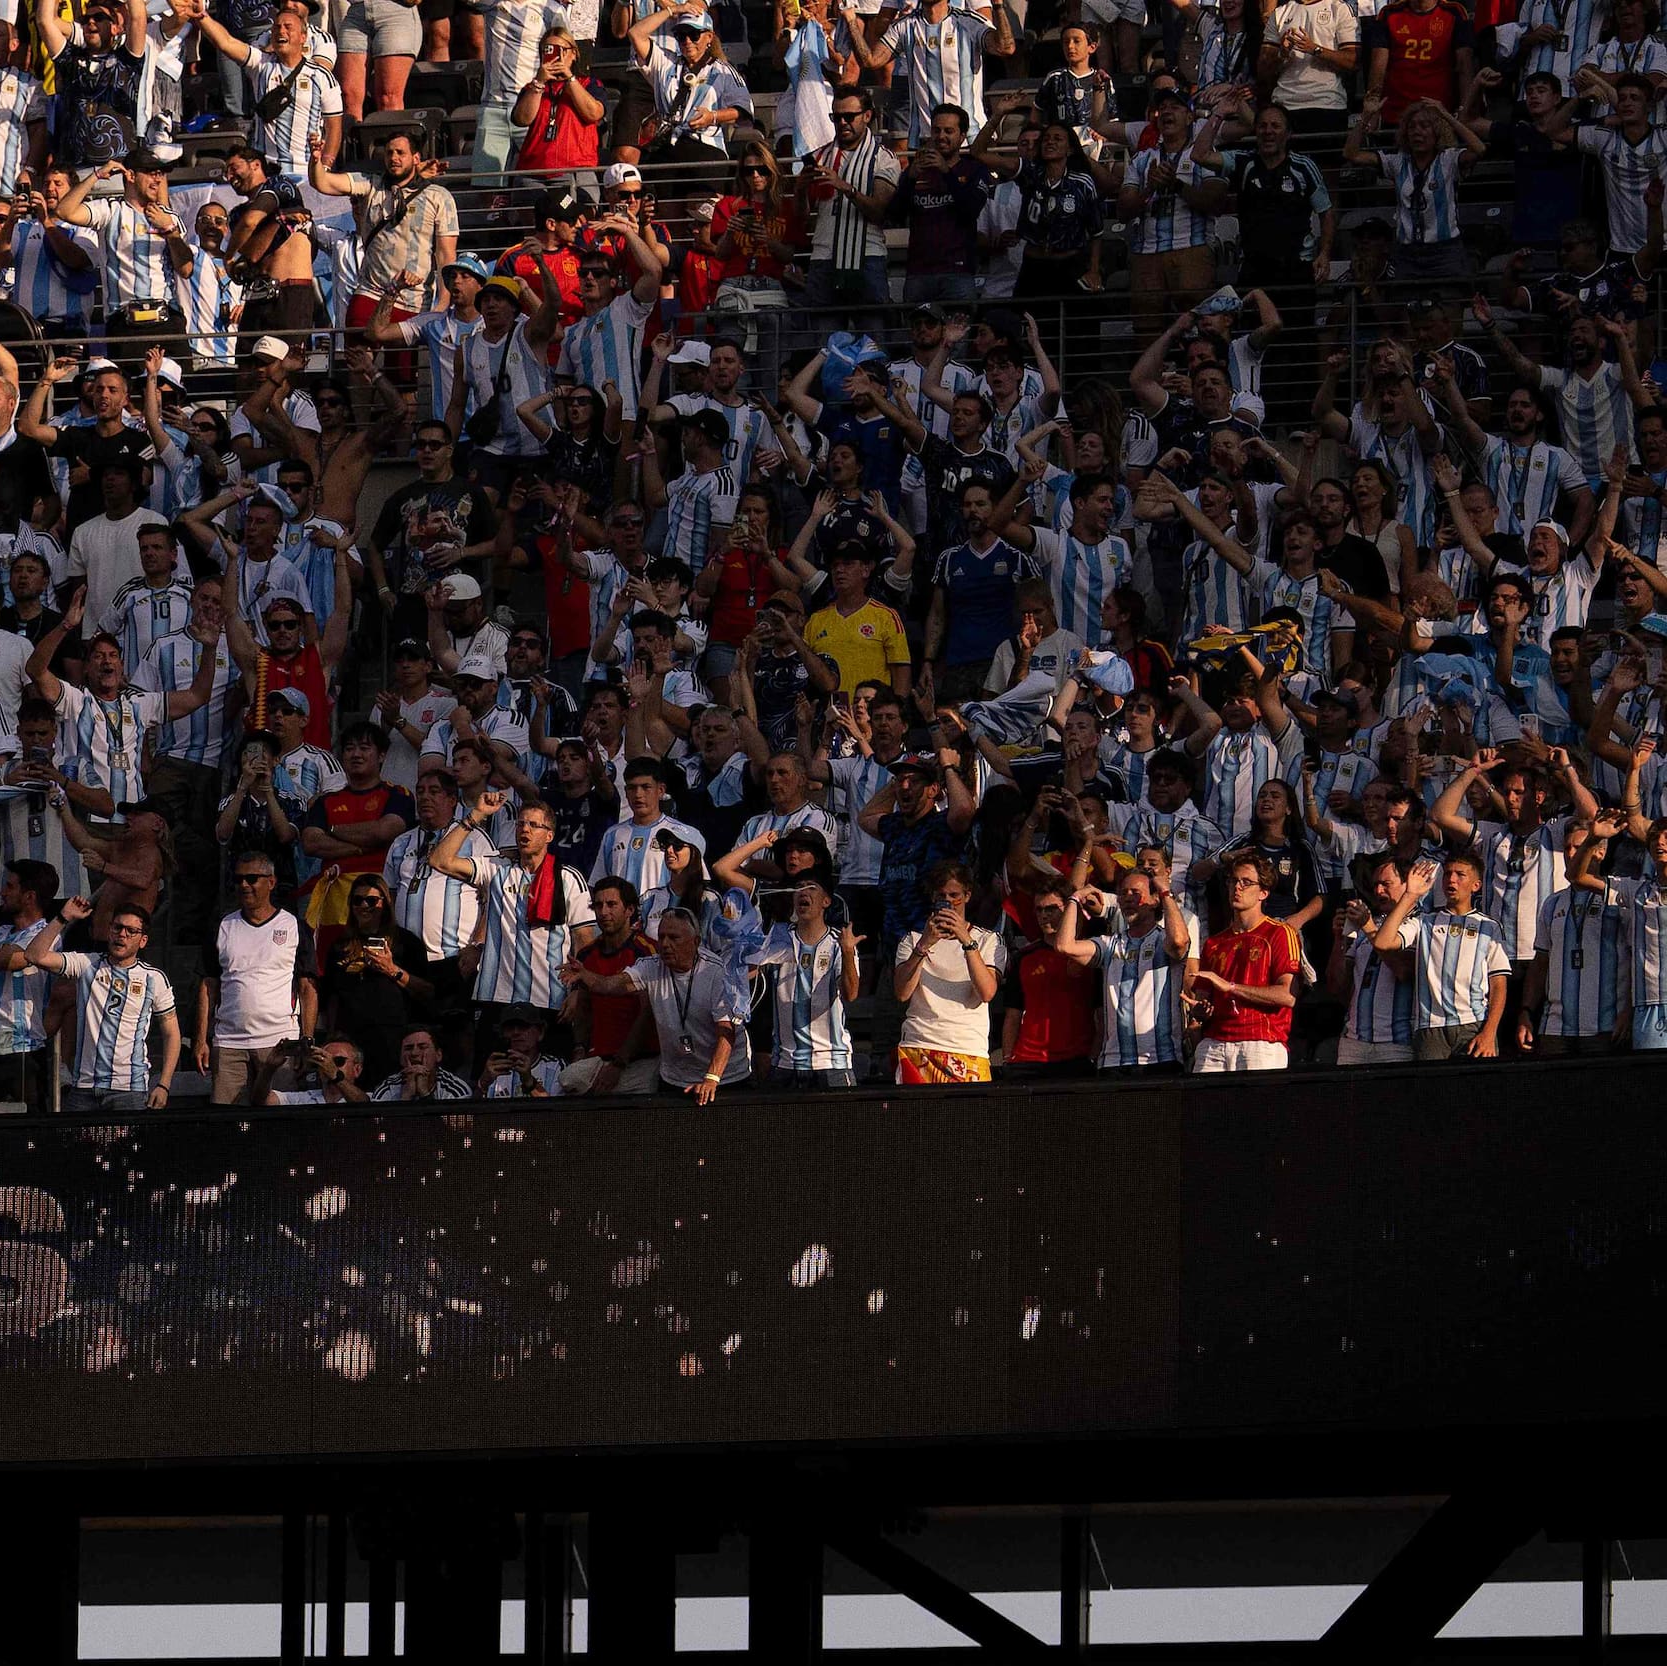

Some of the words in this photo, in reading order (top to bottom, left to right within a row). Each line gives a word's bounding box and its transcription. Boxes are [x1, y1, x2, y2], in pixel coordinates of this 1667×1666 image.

[1404, 38, 1432, 61] 22
[1027, 198, 1041, 224] 10
[921, 401, 934, 423] 10
[943, 467, 957, 493] 10
[153, 601, 169, 620] 10
[557, 825, 586, 848] 24
[107, 994, 121, 1017] 2
